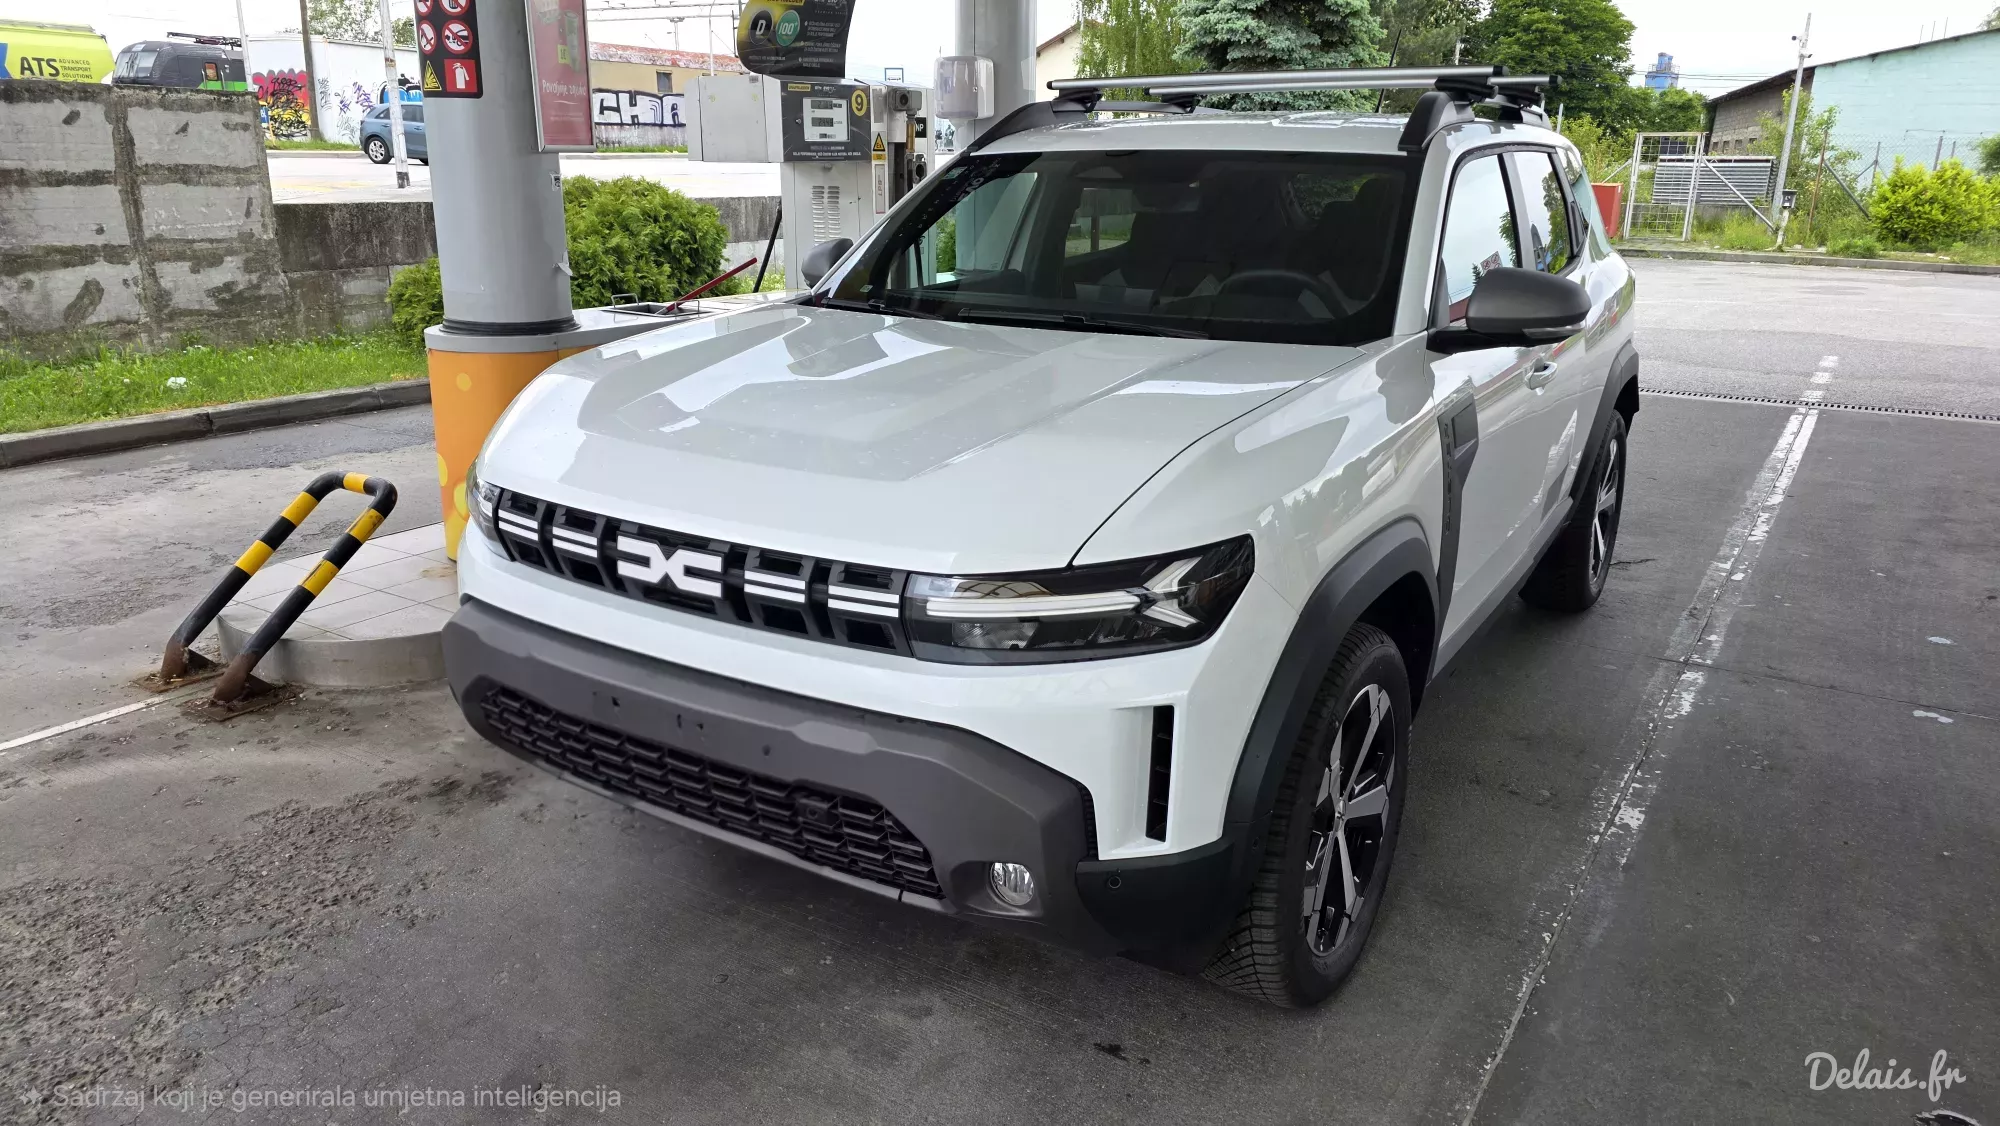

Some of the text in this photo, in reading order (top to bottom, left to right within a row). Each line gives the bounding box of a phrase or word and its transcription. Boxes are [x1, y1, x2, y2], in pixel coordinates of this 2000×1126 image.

[755, 19, 766, 35] D
[20, 56, 60, 77] ATS
[58, 58, 91, 66] ADVANCED
[854, 93, 864, 112] 9
